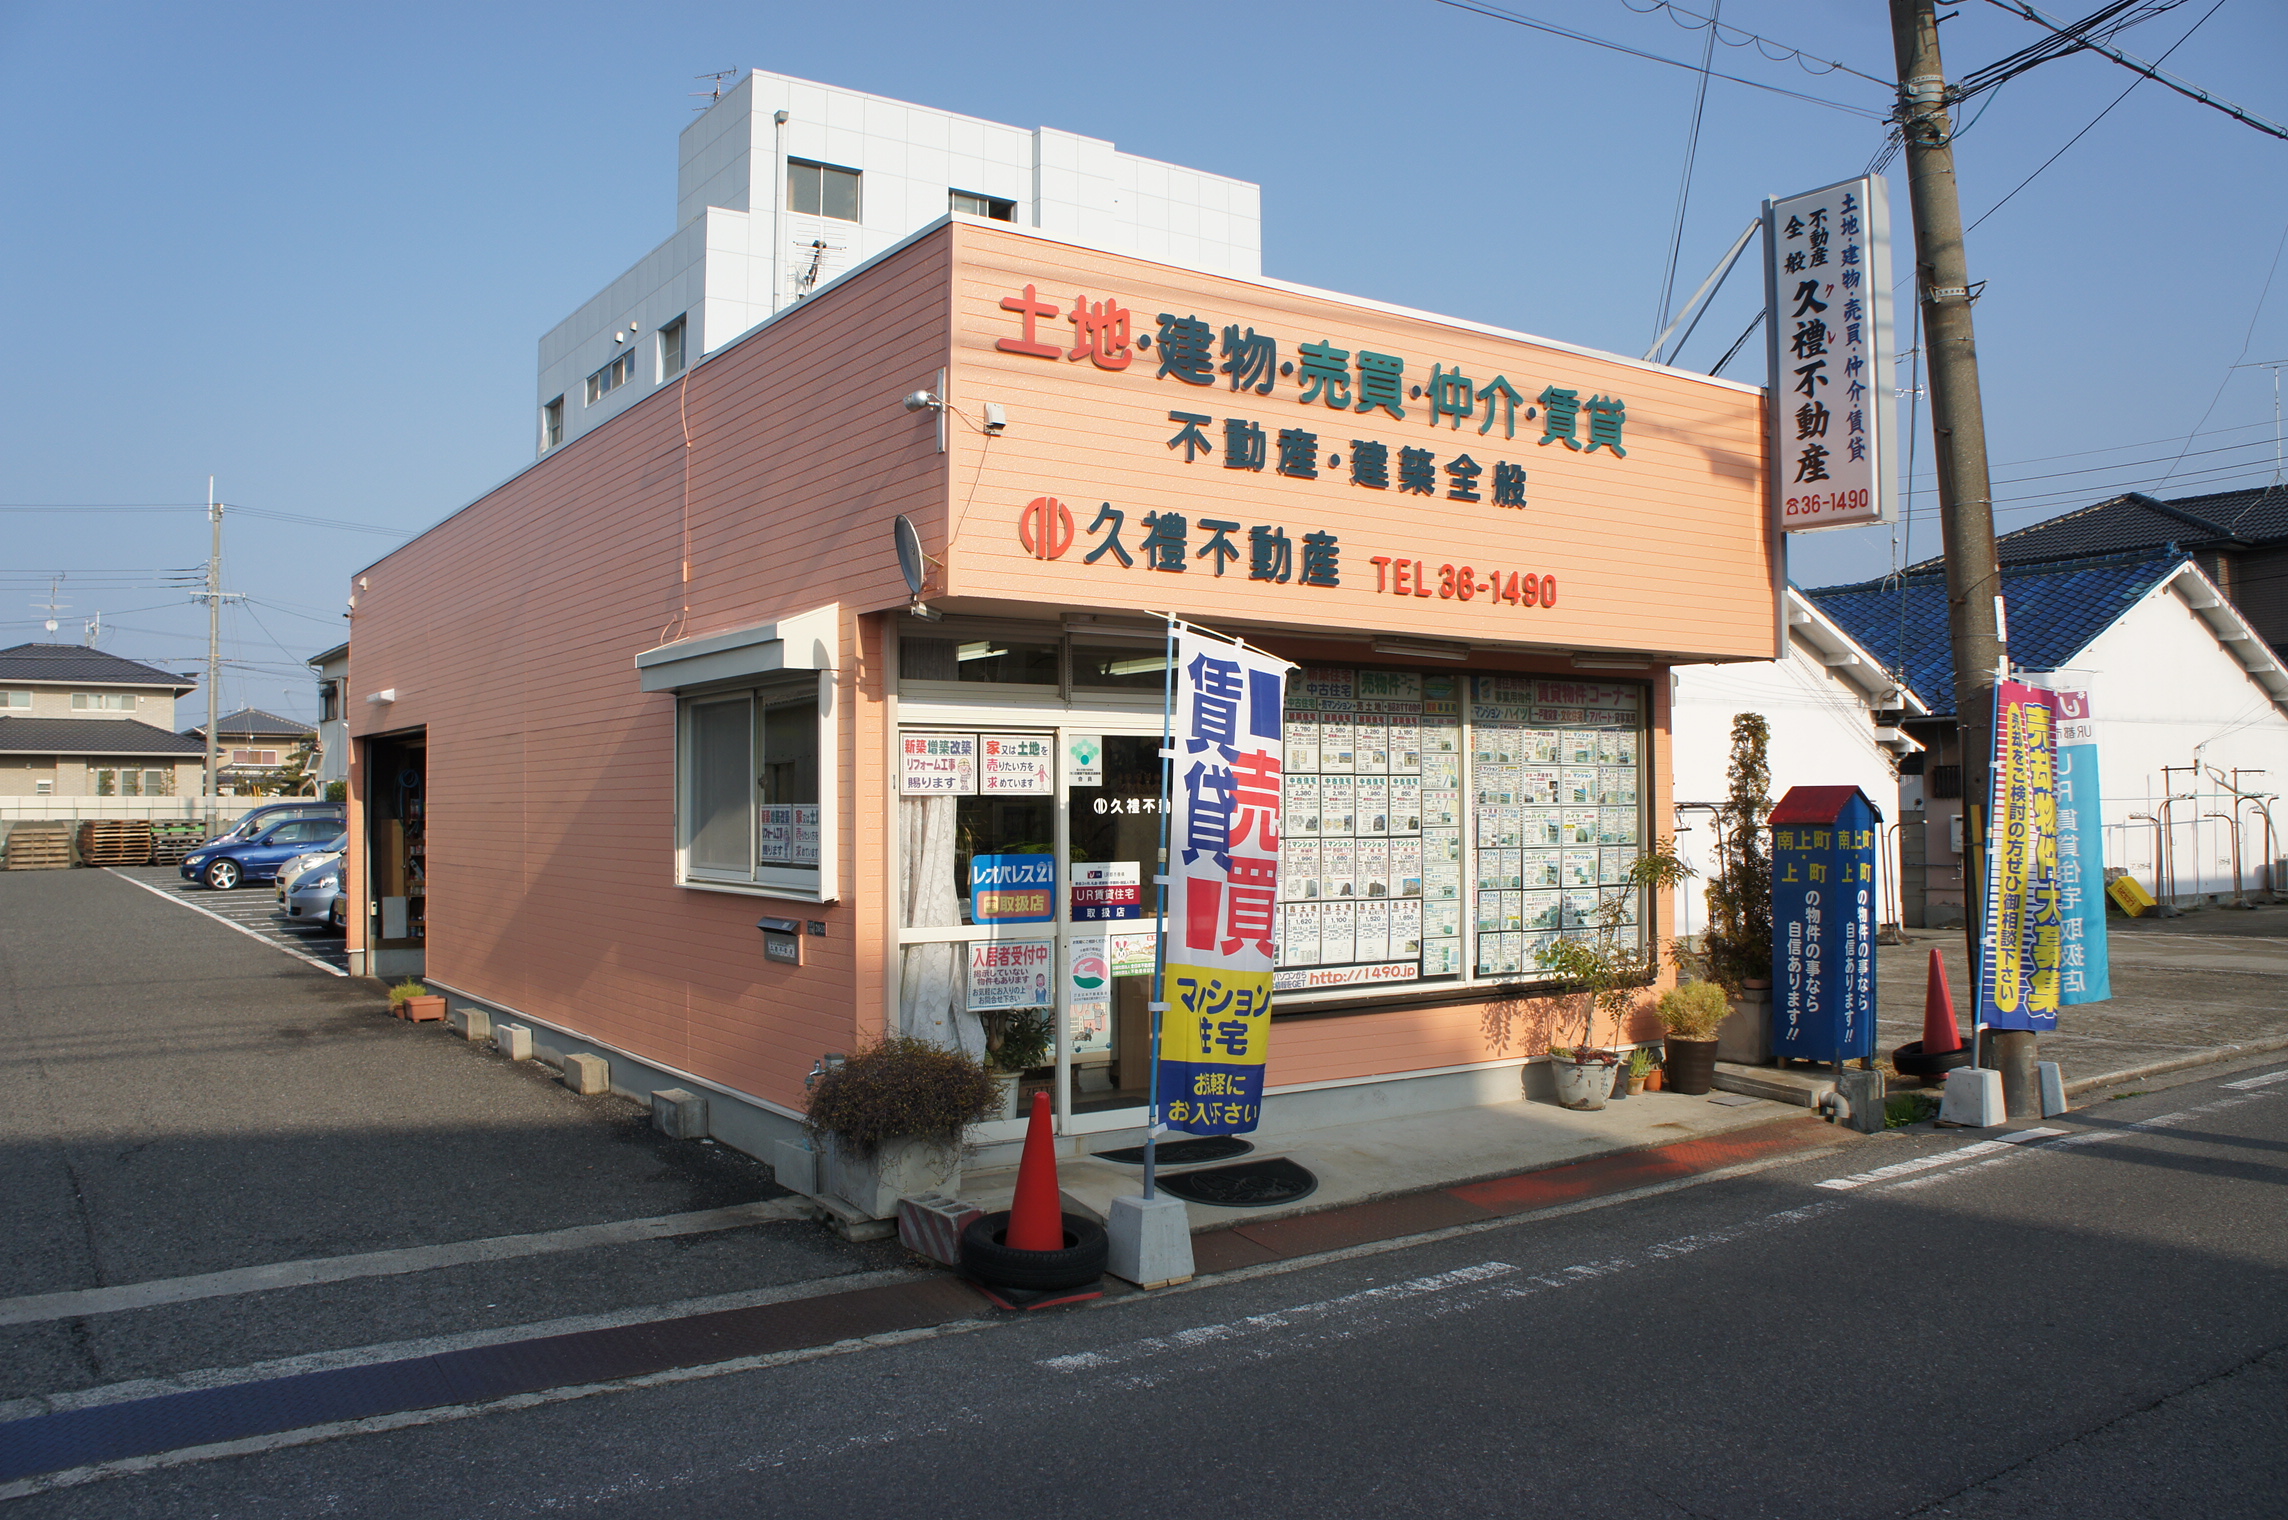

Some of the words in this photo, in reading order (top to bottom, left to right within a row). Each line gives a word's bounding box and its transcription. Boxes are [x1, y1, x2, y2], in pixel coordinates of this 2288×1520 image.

[1784, 215, 1806, 275] 全般
[1809, 208, 1829, 268] 不動産
[1790, 279, 1830, 485] 久禮不動産
[1167, 410, 1529, 509] 不動産・建築全般
[1801, 488, 1869, 514] 36-1490
[1084, 502, 1340, 587] 久禮不動産
[1370, 556, 1433, 599] TEL
[1441, 564, 1558, 608] 36-1490
[1306, 683, 1352, 697] 中古住宅
[905, 739, 972, 755] 新築増築改築
[986, 740, 1048, 757] 家又は土地を
[907, 758, 956, 771] リフォーム工事
[986, 758, 1034, 772] 売りたい方を
[1182, 652, 1244, 873] 賃貸
[908, 776, 956, 789] 賜ります
[986, 776, 1034, 789] 求めています
[1776, 829, 1831, 851] 南上町
[1838, 829, 1874, 850] 南上町
[1220, 749, 1281, 959] 売買
[973, 862, 1054, 885] レオパレス21
[1782, 863, 1827, 883] 上町
[1842, 863, 1872, 883] 上町
[1000, 895, 1045, 913] 取扱店
[1076, 888, 1135, 901] UR賃貸住宅
[1086, 906, 1126, 919] 取扱店
[973, 945, 1048, 968] 入居者受付中
[1805, 890, 1821, 1013] の物件の事なら
[1856, 889, 1870, 1011] の物件の事なら
[973, 968, 1029, 978] 掲示していない
[977, 976, 1029, 986] 物件もあります
[1309, 965, 1416, 985] http://1490.jp
[1193, 1072, 1247, 1096] お軽に
